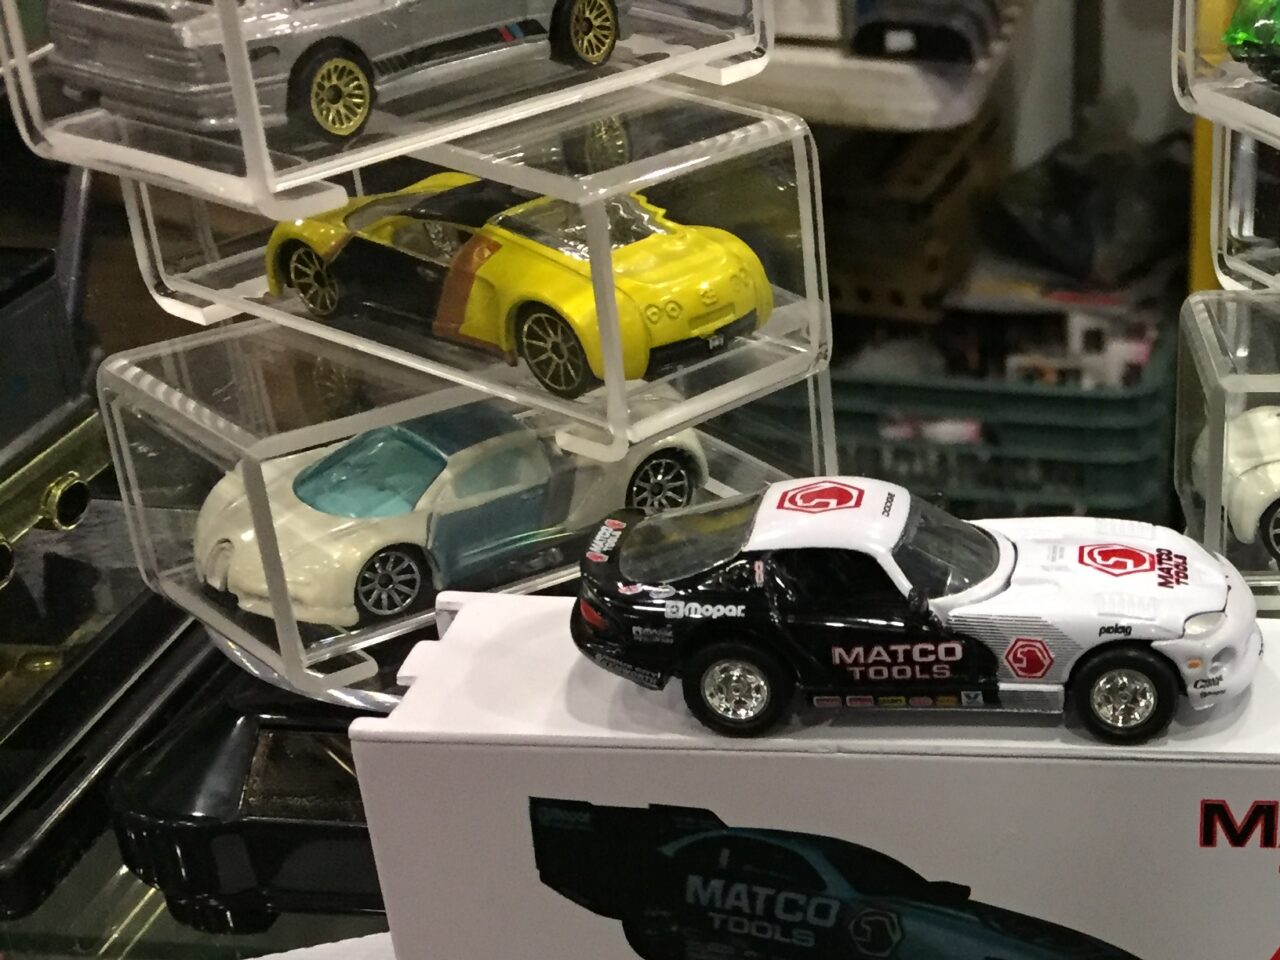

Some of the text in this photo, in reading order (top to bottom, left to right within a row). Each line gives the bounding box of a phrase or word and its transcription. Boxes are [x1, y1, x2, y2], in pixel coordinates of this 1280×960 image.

[1156, 547, 1175, 589] MATCO
[1173, 554, 1189, 586] TOOLS
[831, 641, 964, 666] MATCO
[846, 664, 951, 681] TOOLS
[685, 874, 841, 928] MATCO
[707, 912, 817, 949] TOOLS
